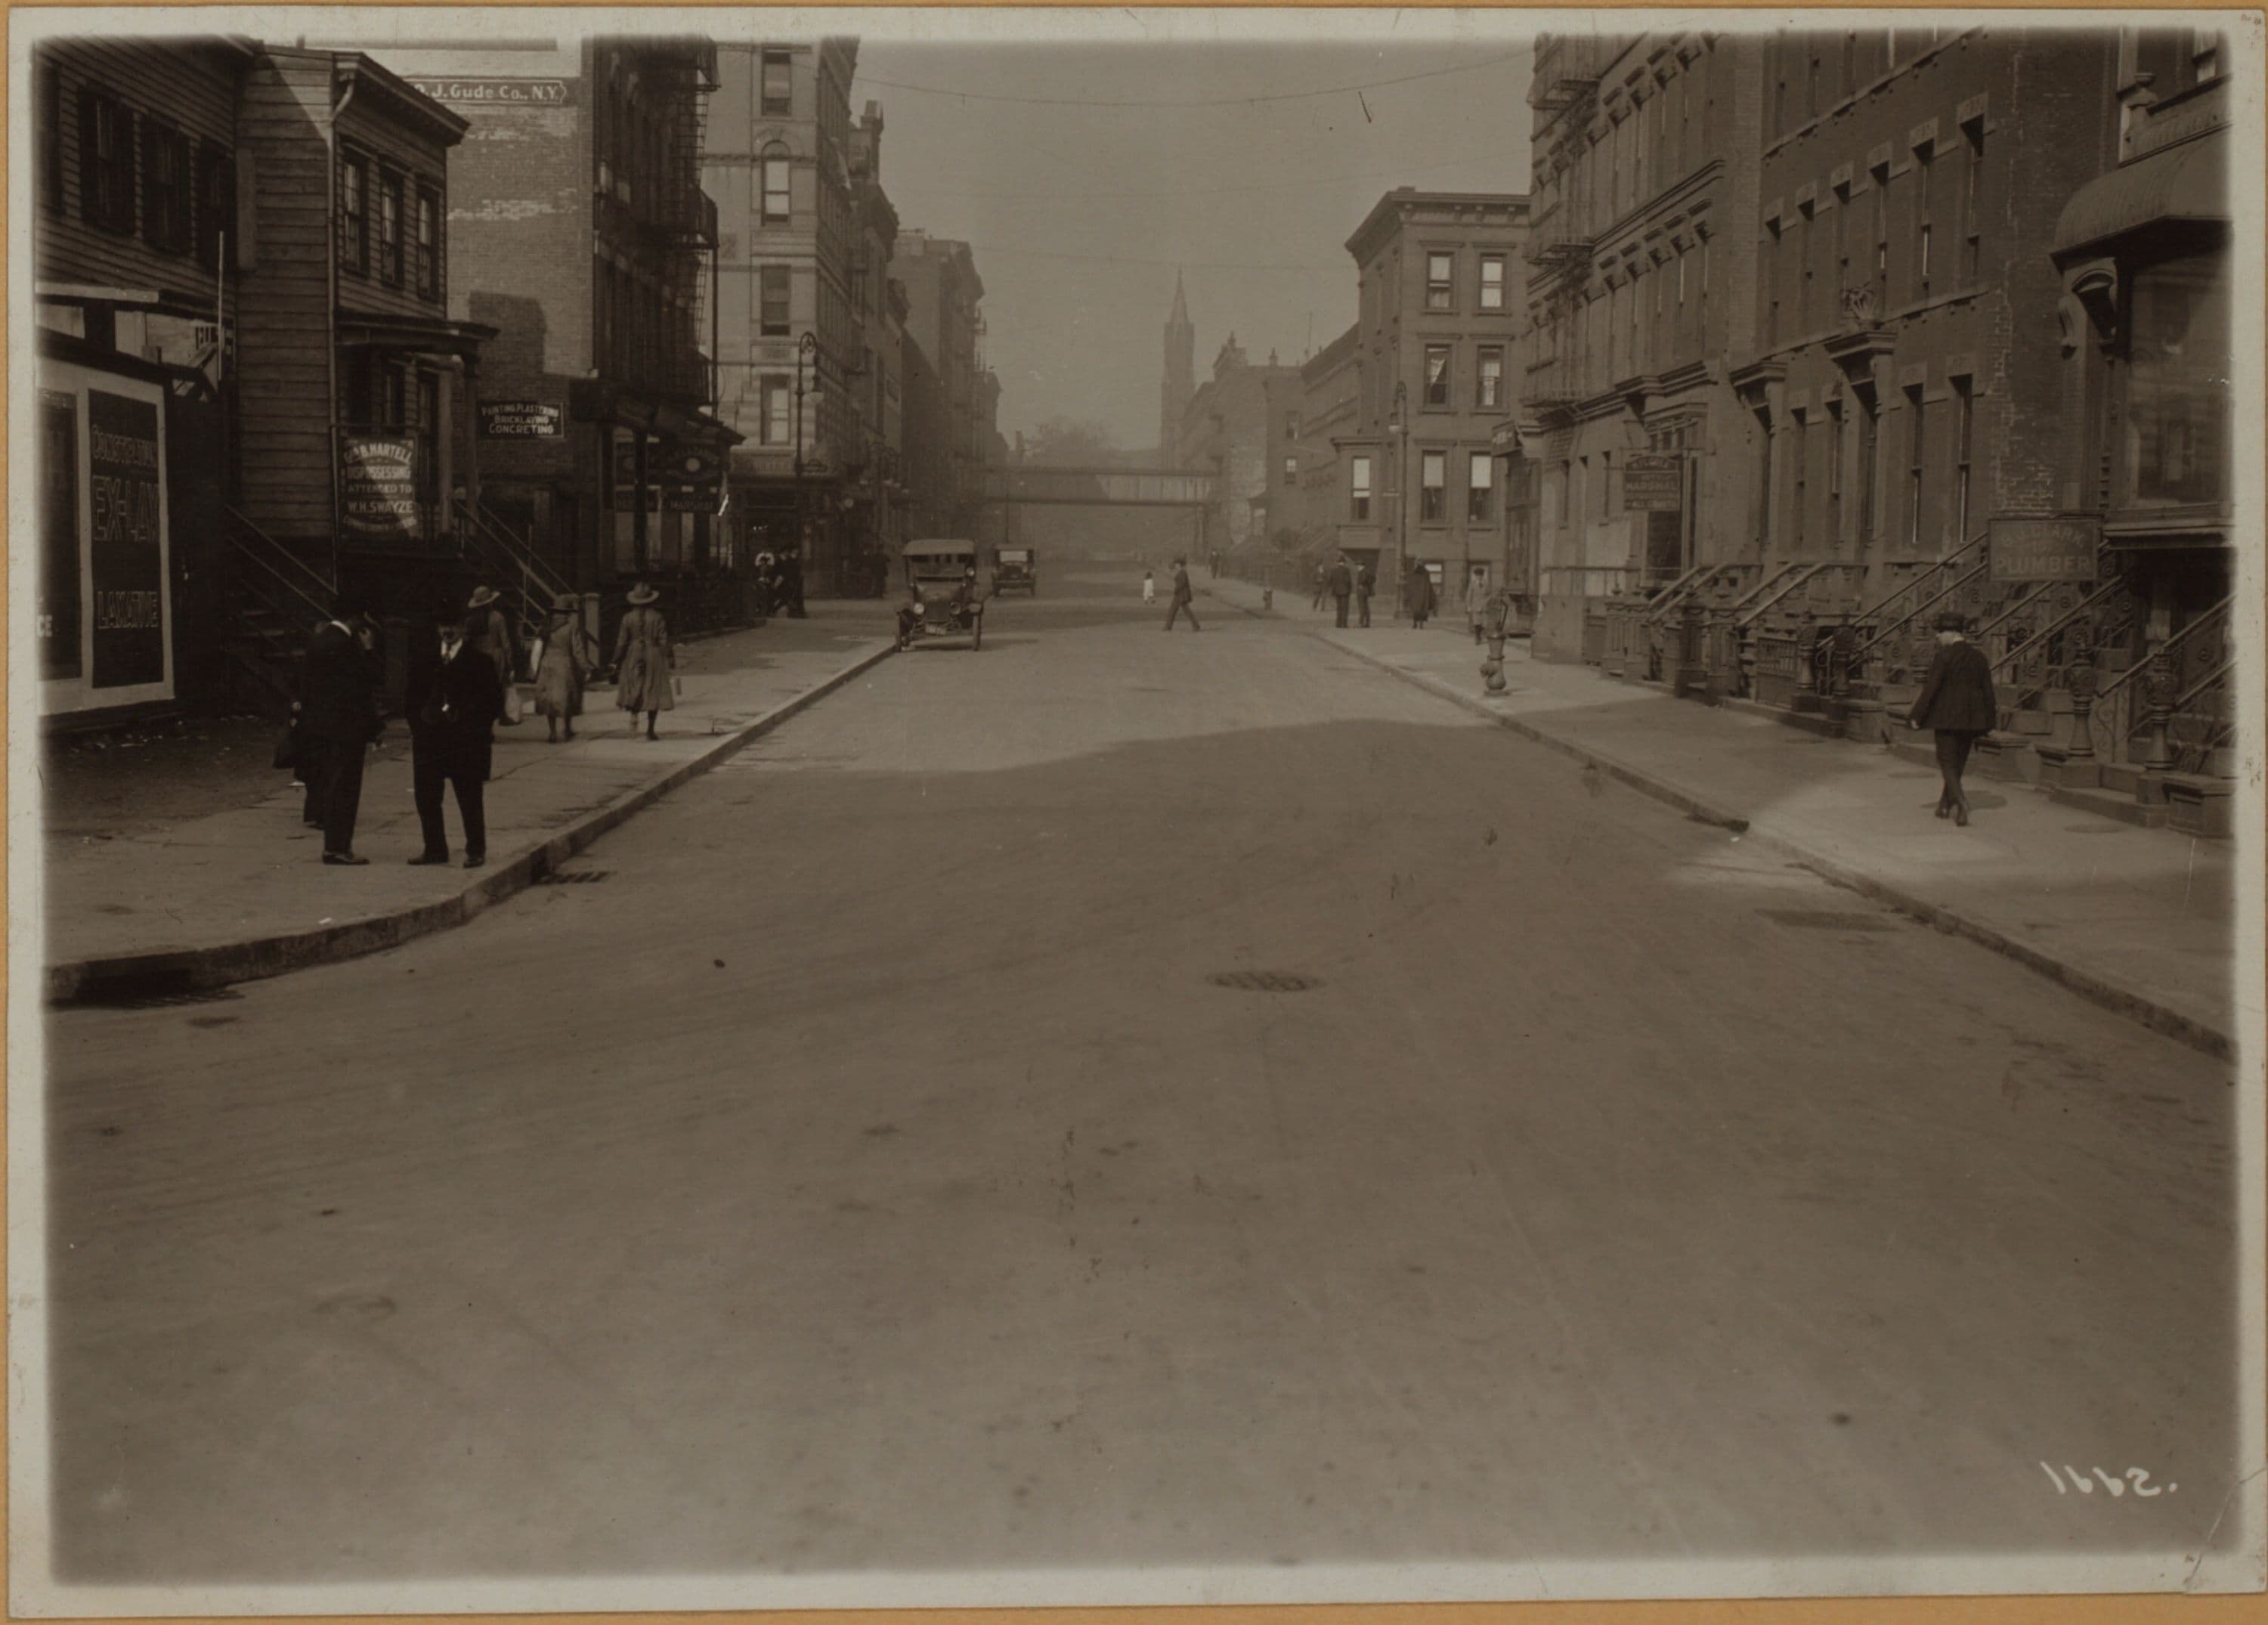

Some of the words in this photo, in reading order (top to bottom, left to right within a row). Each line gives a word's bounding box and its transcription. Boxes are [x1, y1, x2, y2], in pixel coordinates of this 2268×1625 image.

[449, 83, 492, 99] Gude
[489, 423, 554, 435] CONCRETING
[91, 475, 159, 544] EX-LAX
[1994, 556, 2092, 575] PLUMBER
